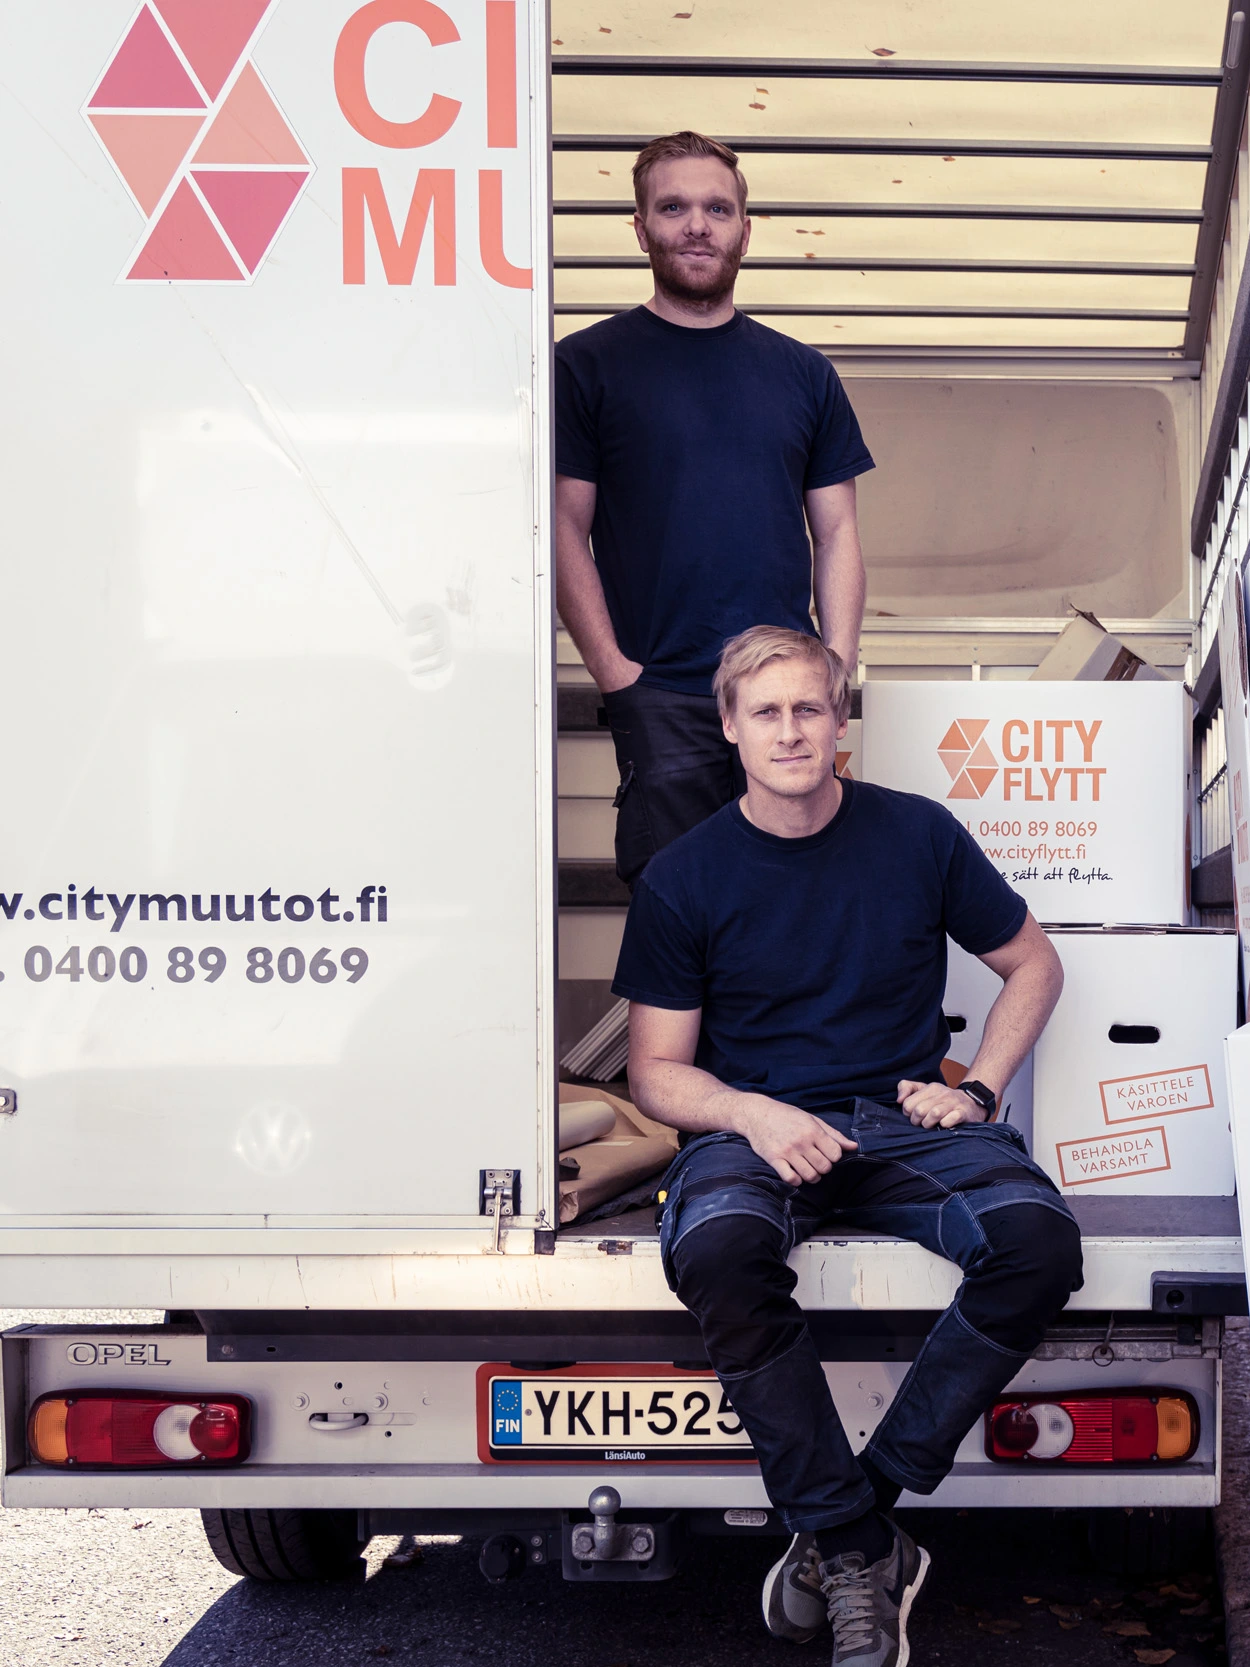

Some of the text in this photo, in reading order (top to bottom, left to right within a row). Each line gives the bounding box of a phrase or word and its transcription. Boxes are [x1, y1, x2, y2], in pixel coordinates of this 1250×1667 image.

[1001, 719, 1103, 763] CITY
[1003, 767, 1107, 801] FLYTT
[979, 820, 1022, 837] 0400
[1028, 820, 1049, 837] 89
[1055, 821, 1098, 837] 8069
[1012, 867, 1039, 882] sätt
[1043, 867, 1064, 880] att
[1068, 867, 1114, 884] flytta.
[24, 945, 370, 984] 0400 89 8069
[1116, 1076, 1195, 1099] KÄSITTELE
[1127, 1092, 1189, 1112] VAROEN
[1071, 1138, 1154, 1162] BEHANDLA
[1080, 1152, 1149, 1174] VARSAMT
[66, 1342, 172, 1366] OPEL
[495, 1419, 520, 1433] FIN
[604, 1451, 646, 1461] LänsiAuto
